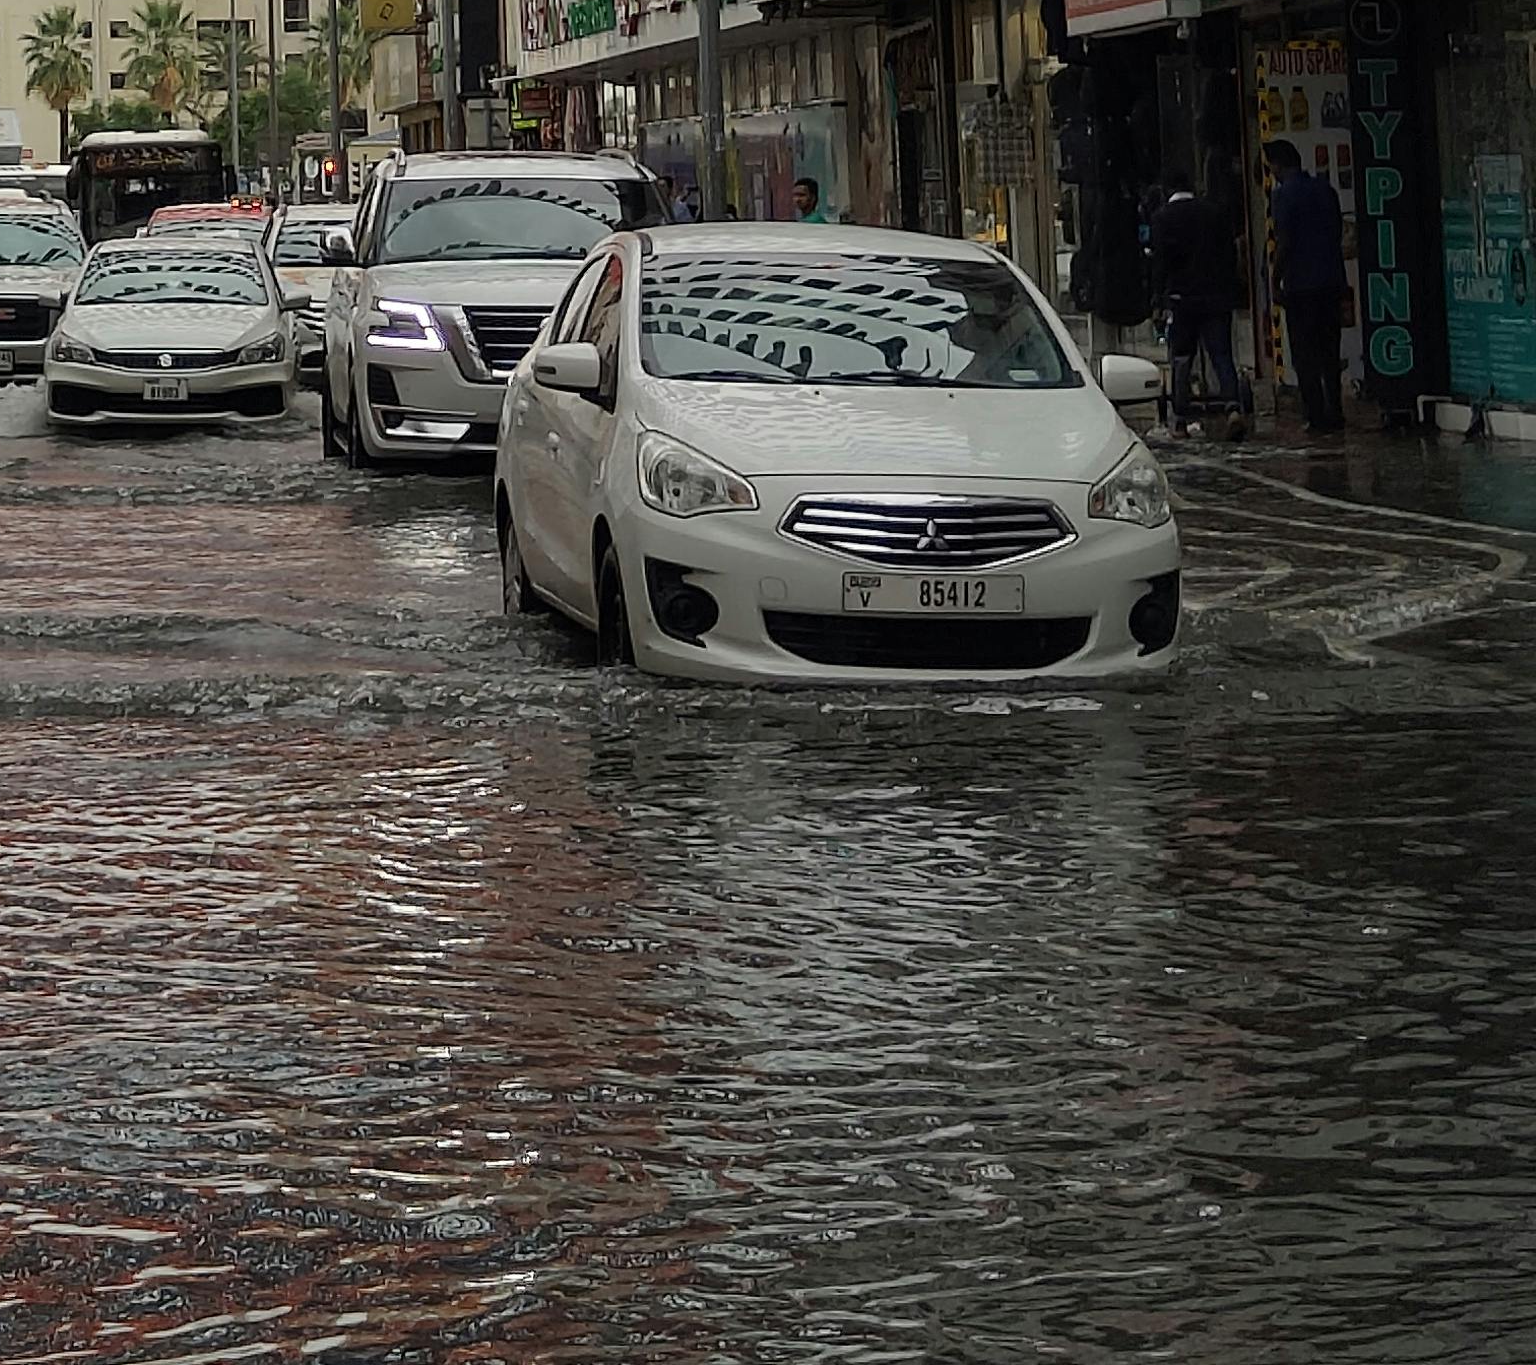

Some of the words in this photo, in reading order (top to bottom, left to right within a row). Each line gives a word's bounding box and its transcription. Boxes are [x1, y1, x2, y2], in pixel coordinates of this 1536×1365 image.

[1356, 58, 1414, 377] TYPING
[859, 591, 871, 608] V
[919, 579, 986, 608] 85412
